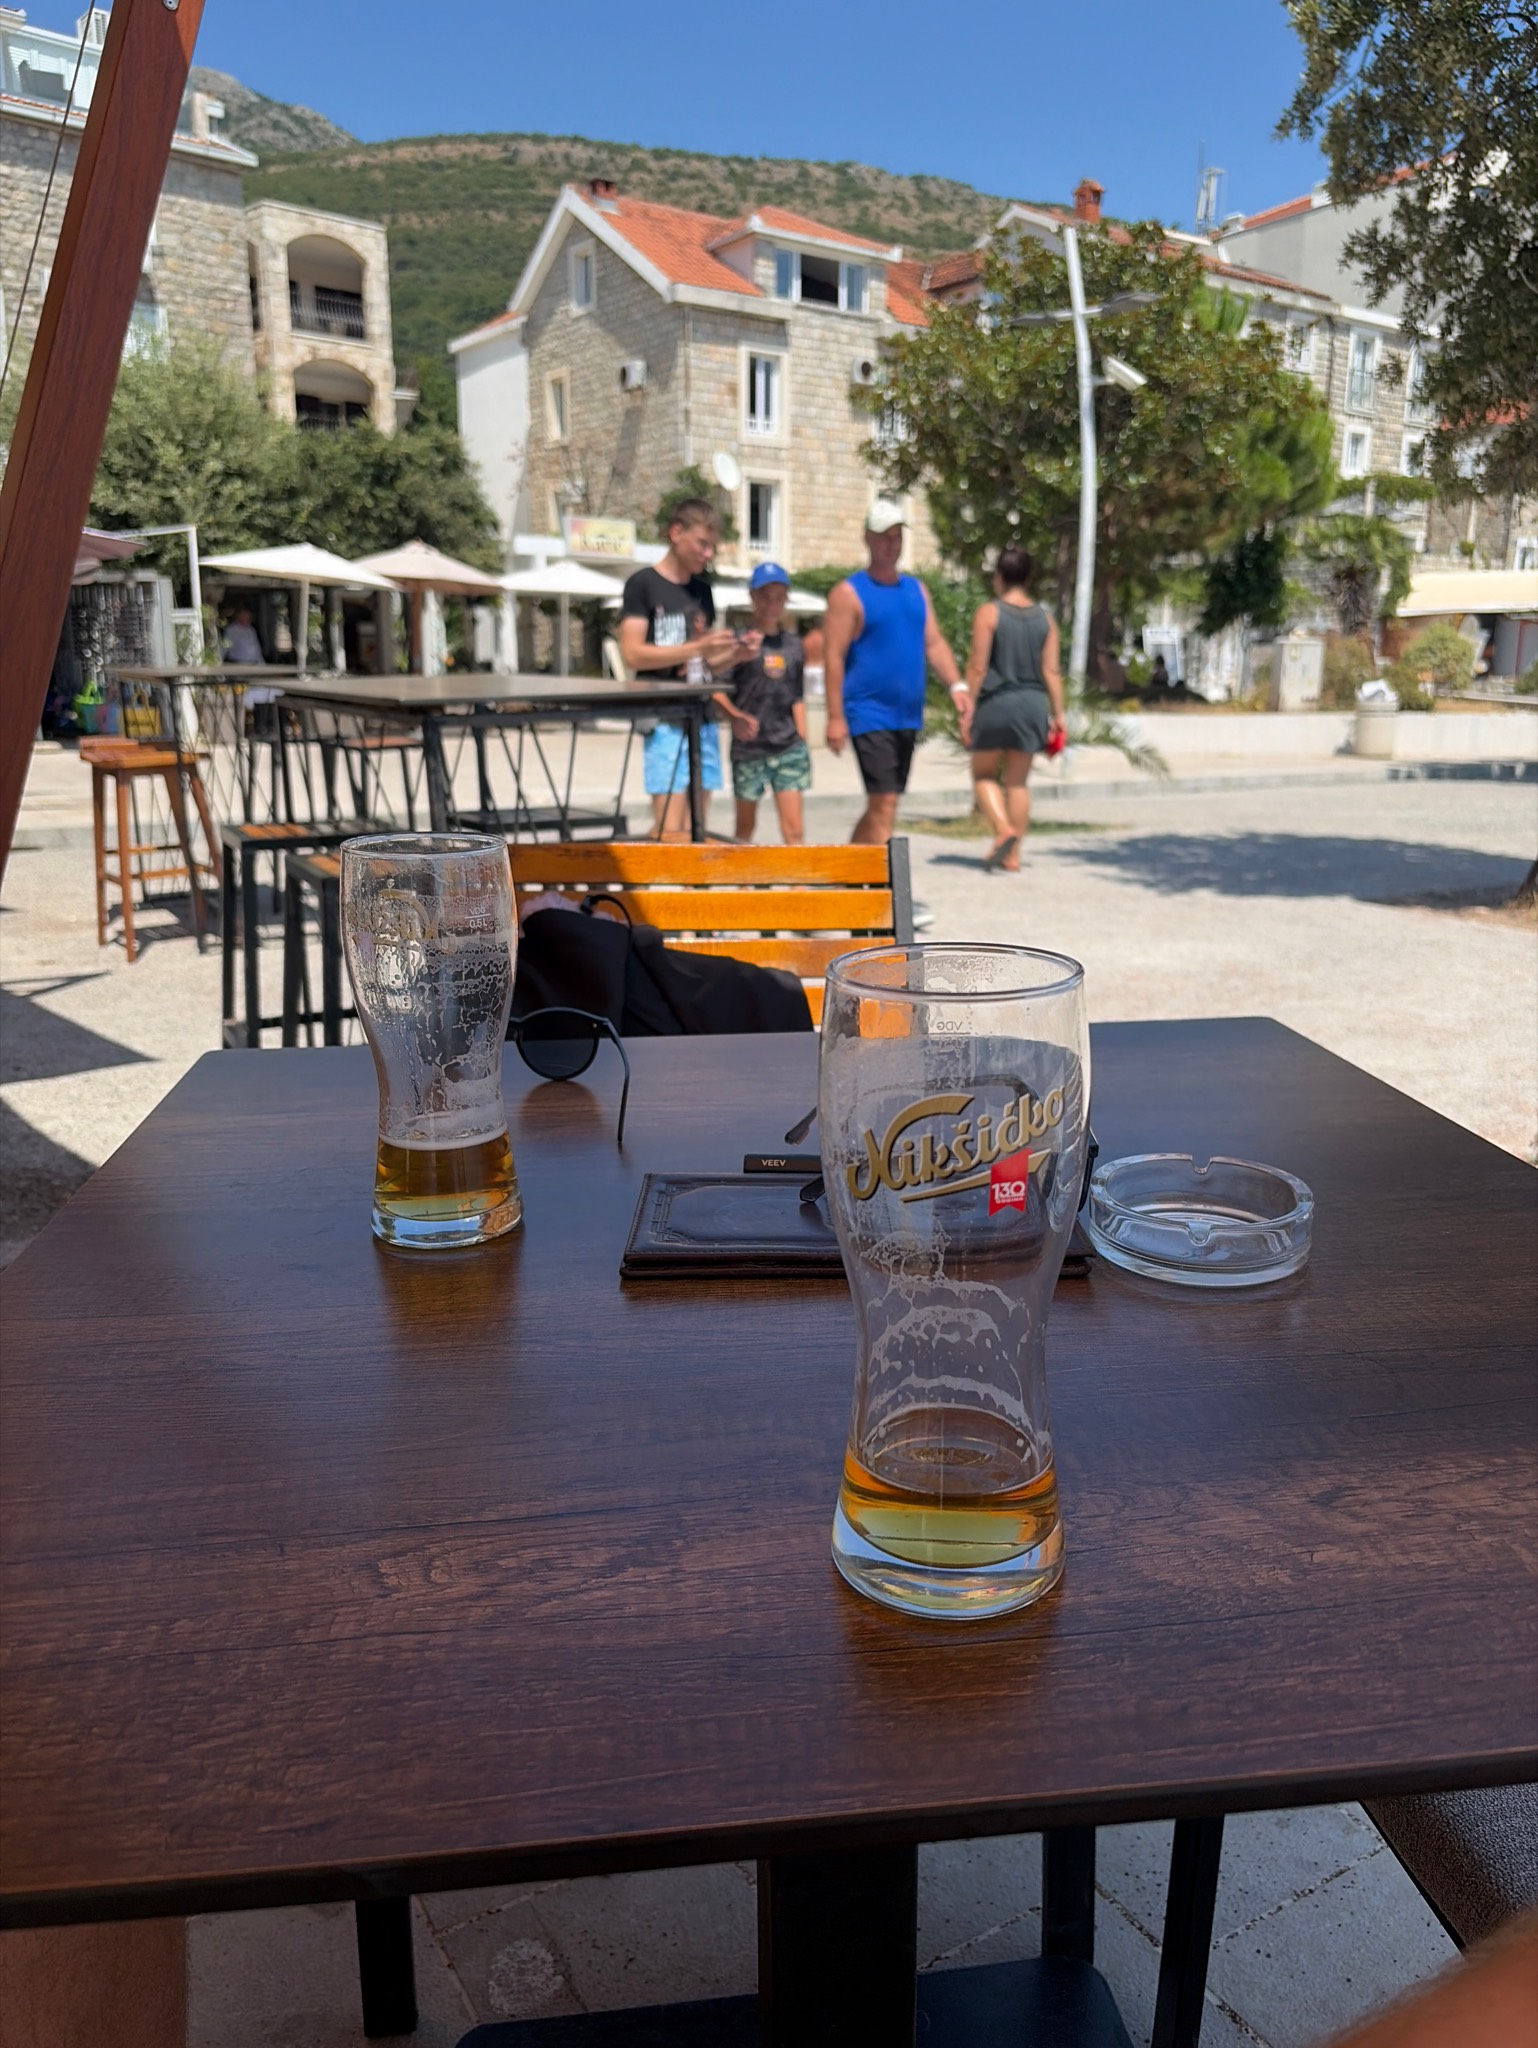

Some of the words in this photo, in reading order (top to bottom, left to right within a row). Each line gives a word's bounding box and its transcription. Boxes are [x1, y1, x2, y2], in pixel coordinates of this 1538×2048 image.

[846, 1086, 1066, 1200] Nikšićko
[761, 1159, 787, 1167] VEEV
[991, 1181, 1026, 1200] 130
